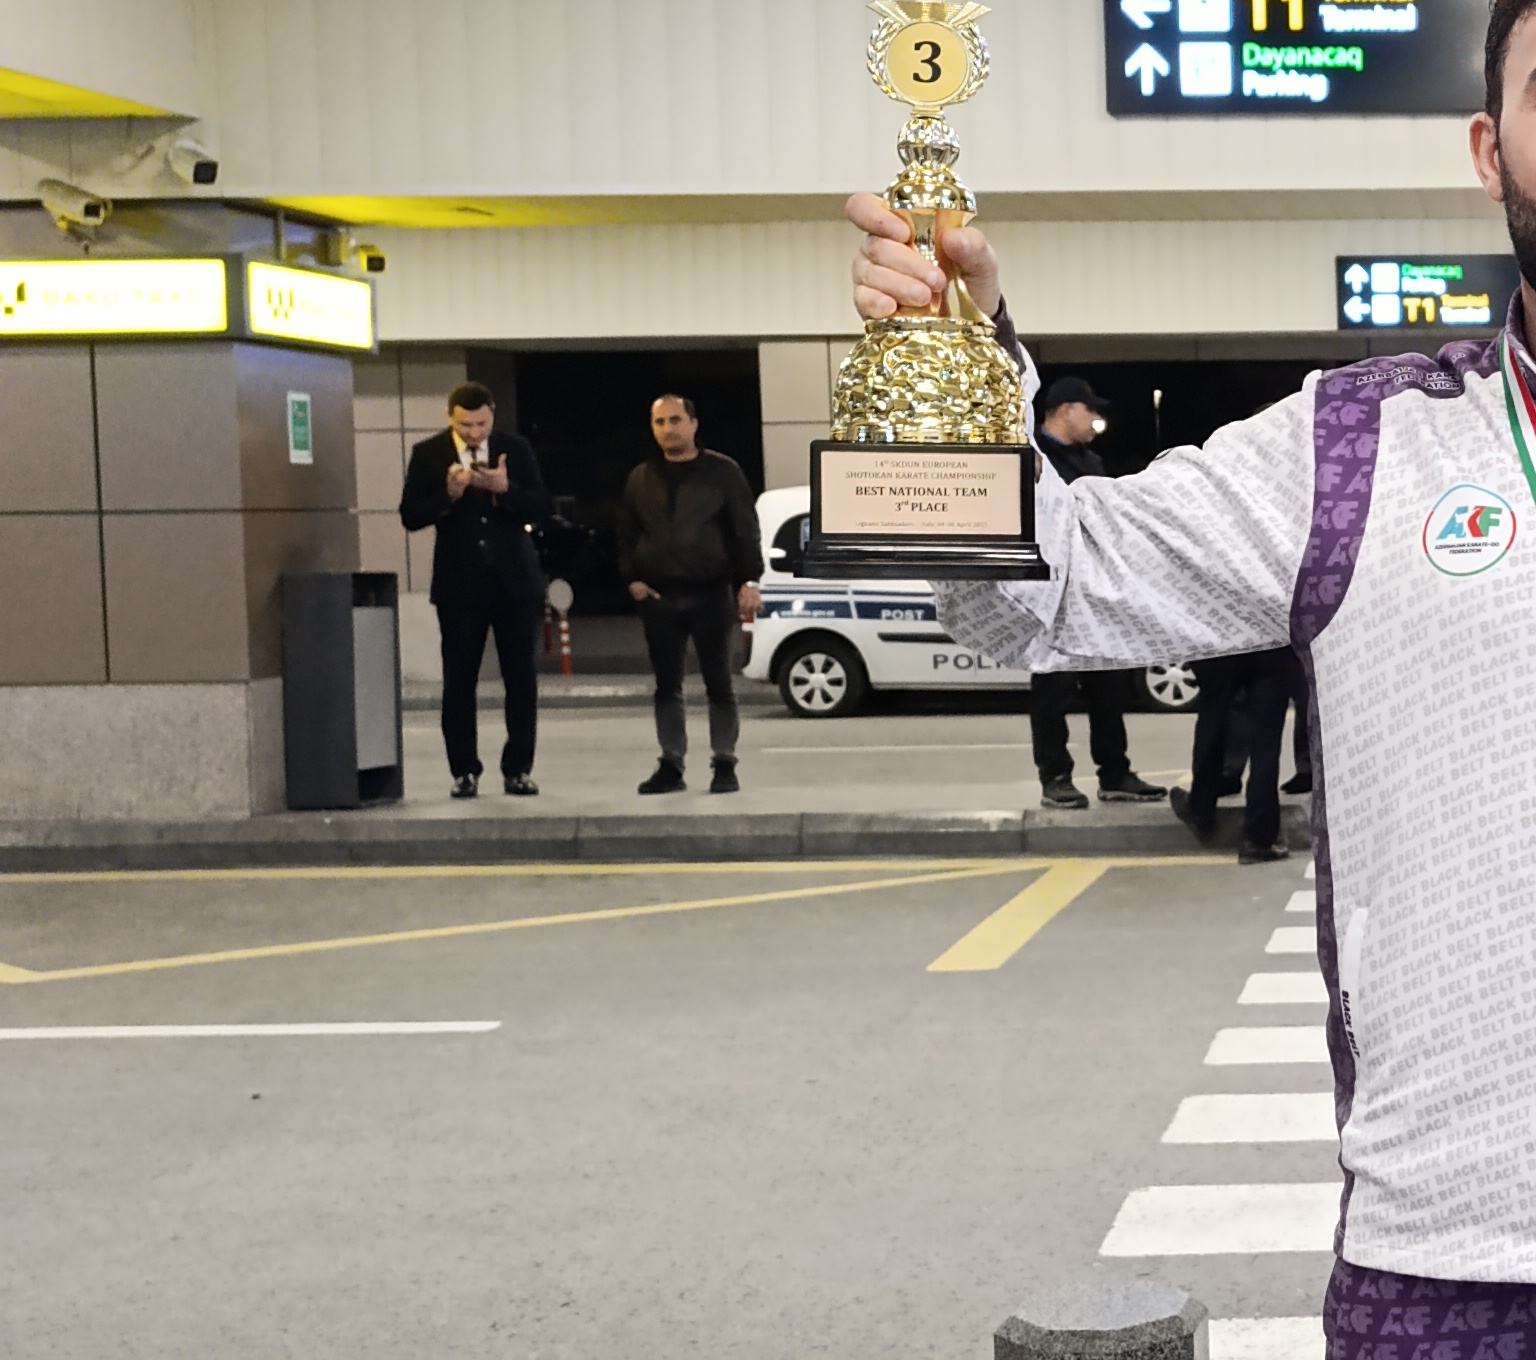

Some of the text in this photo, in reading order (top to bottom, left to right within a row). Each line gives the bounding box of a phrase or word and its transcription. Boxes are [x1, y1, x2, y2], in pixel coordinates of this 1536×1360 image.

[912, 40, 942, 83] 3
[1242, 42, 1364, 71] Dayanacaq
[1403, 297, 1435, 322] T1
[922, 461, 968, 469] EUROPEAN
[1257, 444, 1282, 467] BELT
[845, 471, 893, 479] SHOTOKAN
[931, 472, 997, 480] CHAMPIONSHIP
[1236, 453, 1272, 486] BLACK
[855, 486, 988, 497] BEST NATIONAL TEAM
[895, 500, 949, 512] 3rd PLACE
[1371, 594, 1400, 610] BELT
[1408, 583, 1440, 608] BELT
[1450, 584, 1487, 608] BELT
[1494, 582, 1534, 601] BELT
[881, 609, 925, 621] POST
[1208, 608, 1242, 635] BELT
[1225, 603, 1270, 637] BLACK
[1330, 608, 1366, 635] BLACK
[1363, 608, 1400, 632] BLACK
[1402, 607, 1443, 632] BLACK
[1439, 600, 1487, 630] BLACK
[1480, 603, 1533, 632] BLACK
[1328, 629, 1355, 650] BELT
[1364, 630, 1393, 651] BELT
[1400, 624, 1429, 648] BELT
[1440, 626, 1473, 648] BELT
[1484, 624, 1520, 649] BELT
[1326, 651, 1361, 676] BLACK
[1358, 644, 1396, 674] BLACK
[1396, 648, 1434, 676] BLACK
[1431, 645, 1476, 674] BLACK
[1470, 646, 1520, 677] BLACK
[1325, 670, 1351, 692] BELT
[1359, 672, 1388, 692] BELT
[1394, 670, 1422, 690] BELT
[1435, 670, 1466, 691] BELT
[1324, 691, 1361, 715] BLACK
[1352, 690, 1390, 716] BLACK
[1390, 690, 1428, 718] BLACK
[1460, 688, 1507, 720] BLACK
[1354, 715, 1382, 737] BELT
[1457, 866, 1506, 896] BLACK
[1422, 892, 1451, 909] BELT
[1456, 891, 1491, 912] BELT
[1500, 892, 1535, 915] BELT
[1379, 904, 1416, 930] BLACK
[1412, 906, 1450, 933] BLACK
[1447, 908, 1492, 934] BLACK
[1486, 908, 1534, 940] BLACK
[1380, 930, 1407, 950] BELT
[1448, 933, 1480, 955] BELT
[1489, 935, 1524, 956] BELT
[1438, 950, 1483, 978] BLACK
[1477, 954, 1527, 981] BLACK
[1439, 975, 1471, 996] BELT
[1341, 990, 1352, 1029] BLACK
[1469, 997, 1515, 1024] BLACK
[1430, 1015, 1462, 1036] BELT
[1471, 1020, 1504, 1040] BELT
[1423, 1034, 1465, 1061] BLACK
